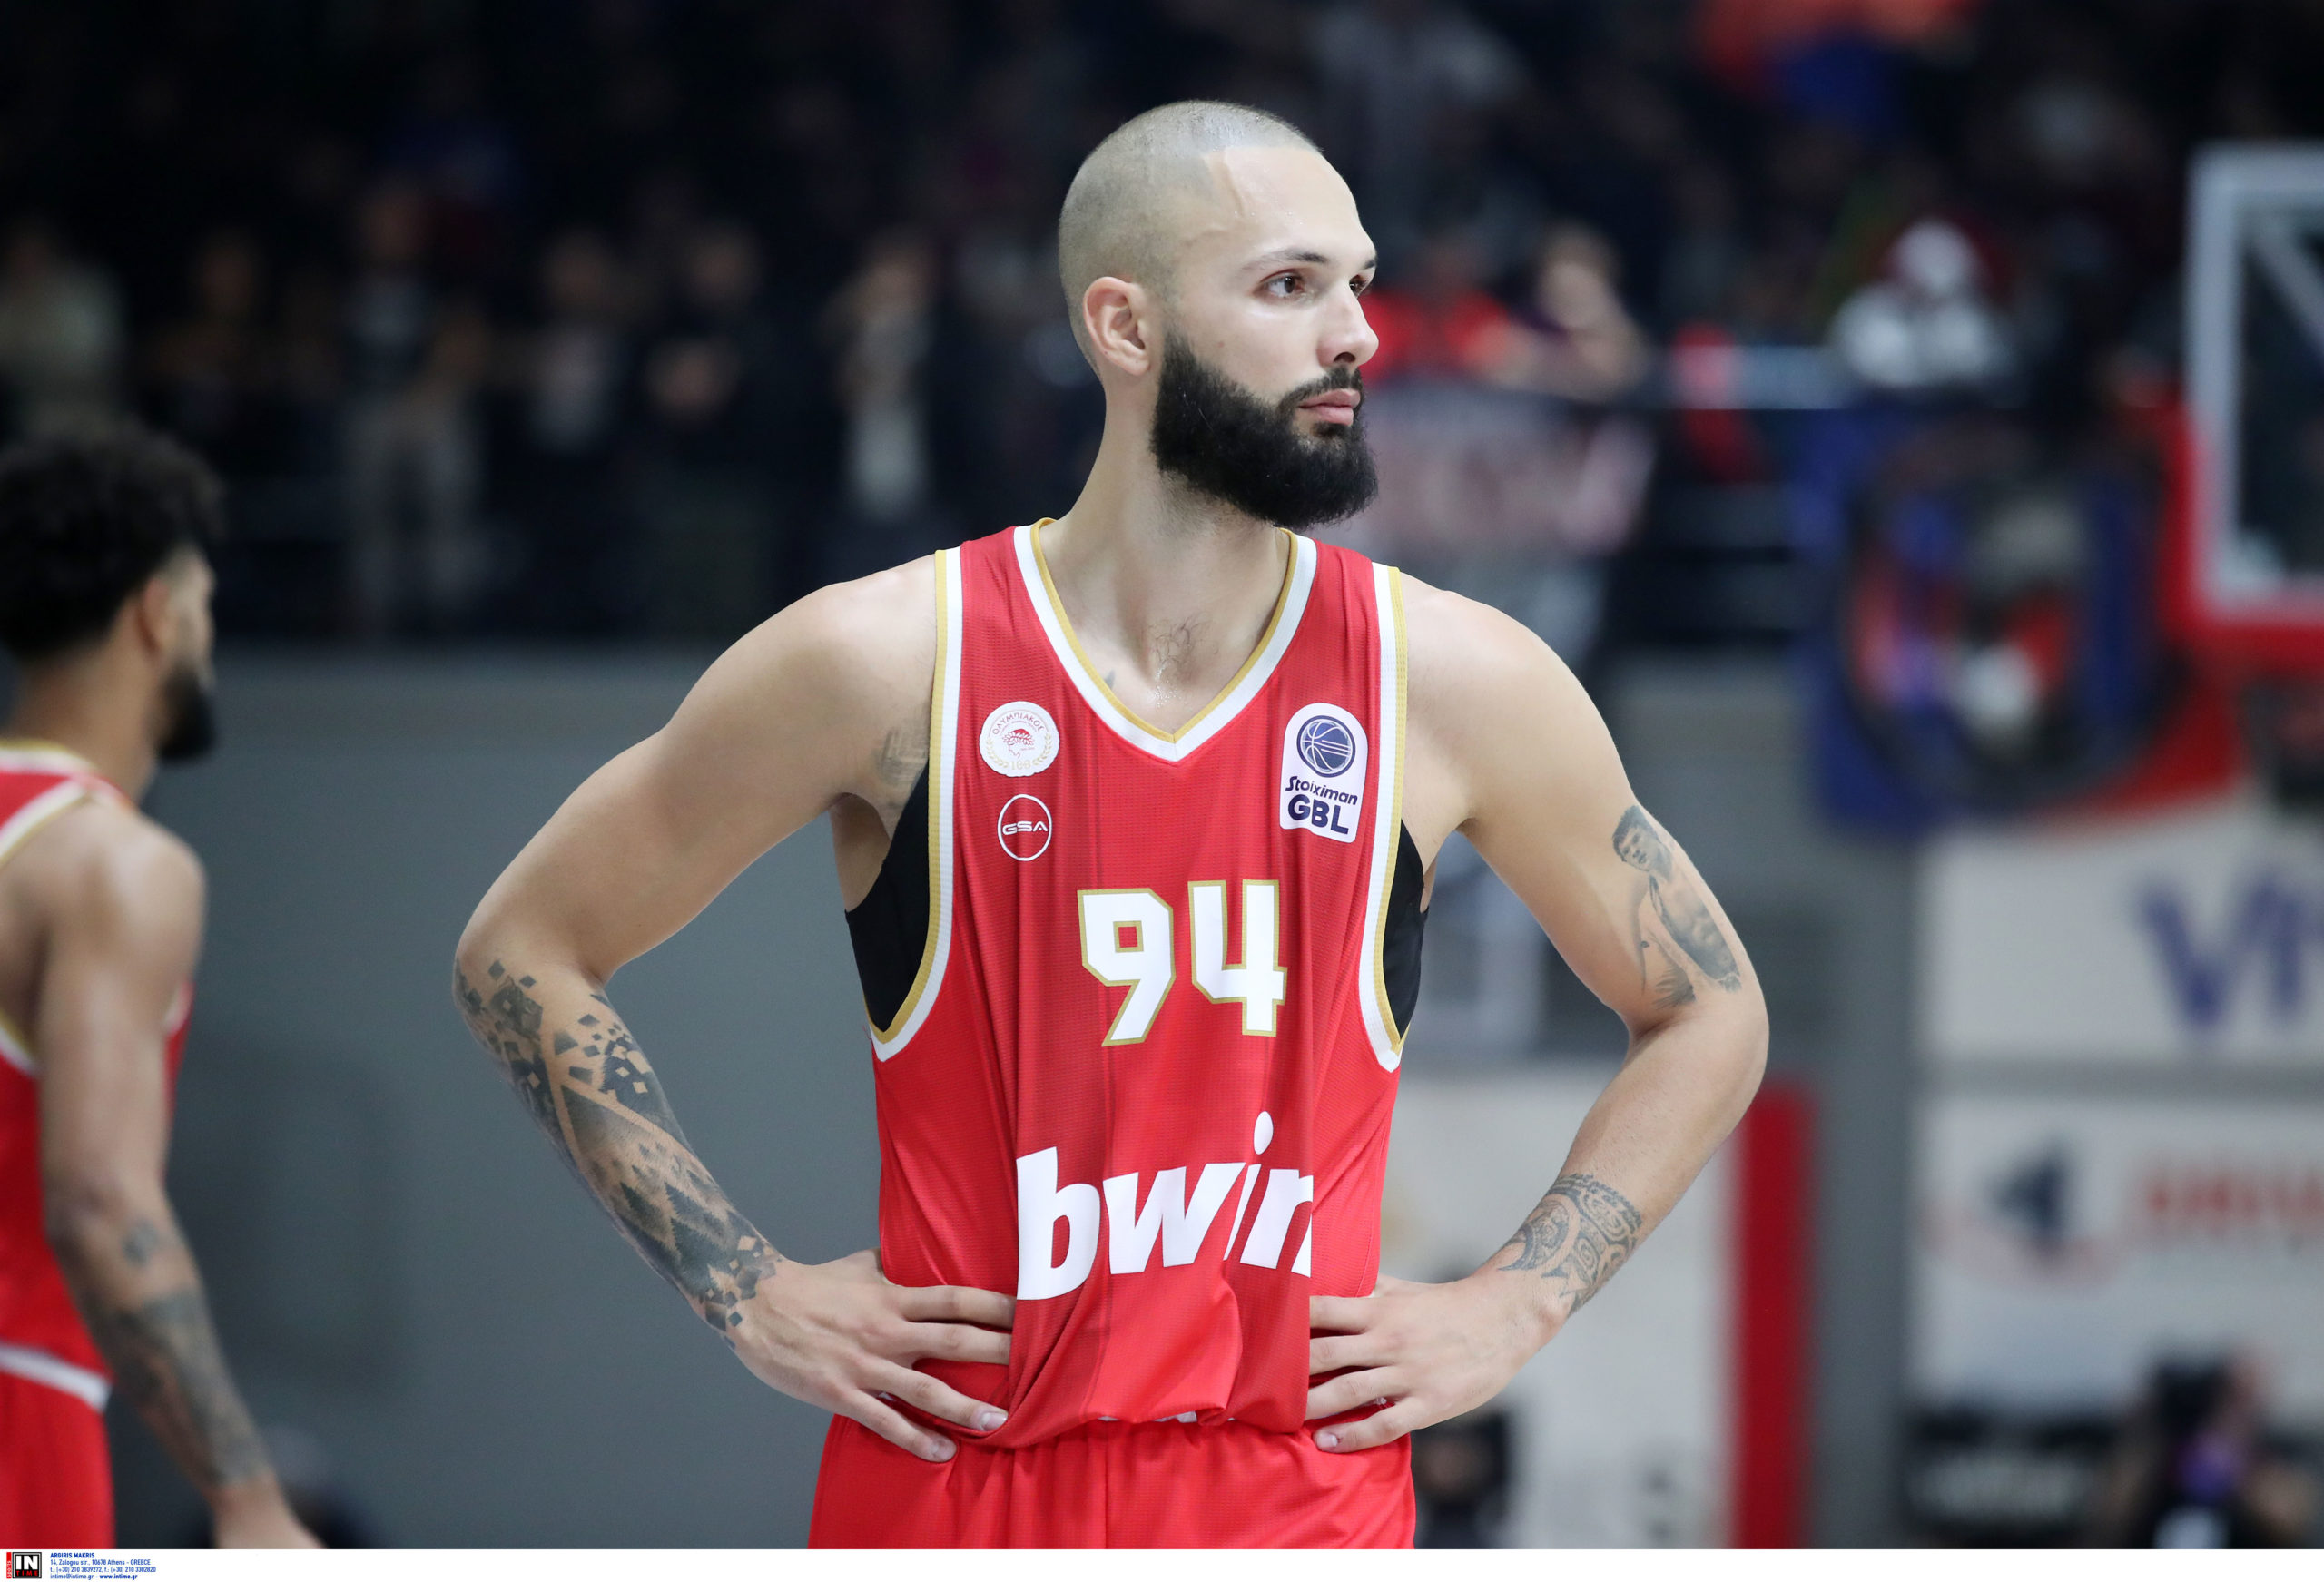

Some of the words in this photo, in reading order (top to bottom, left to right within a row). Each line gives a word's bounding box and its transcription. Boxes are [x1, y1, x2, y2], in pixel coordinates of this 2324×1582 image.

[1285, 776, 1358, 805] Stoiximan
[1002, 820, 1049, 836] GSA
[1287, 793, 1349, 835] GBL
[1077, 879, 1288, 1046] 94
[1015, 1110, 1315, 1301] bwin
